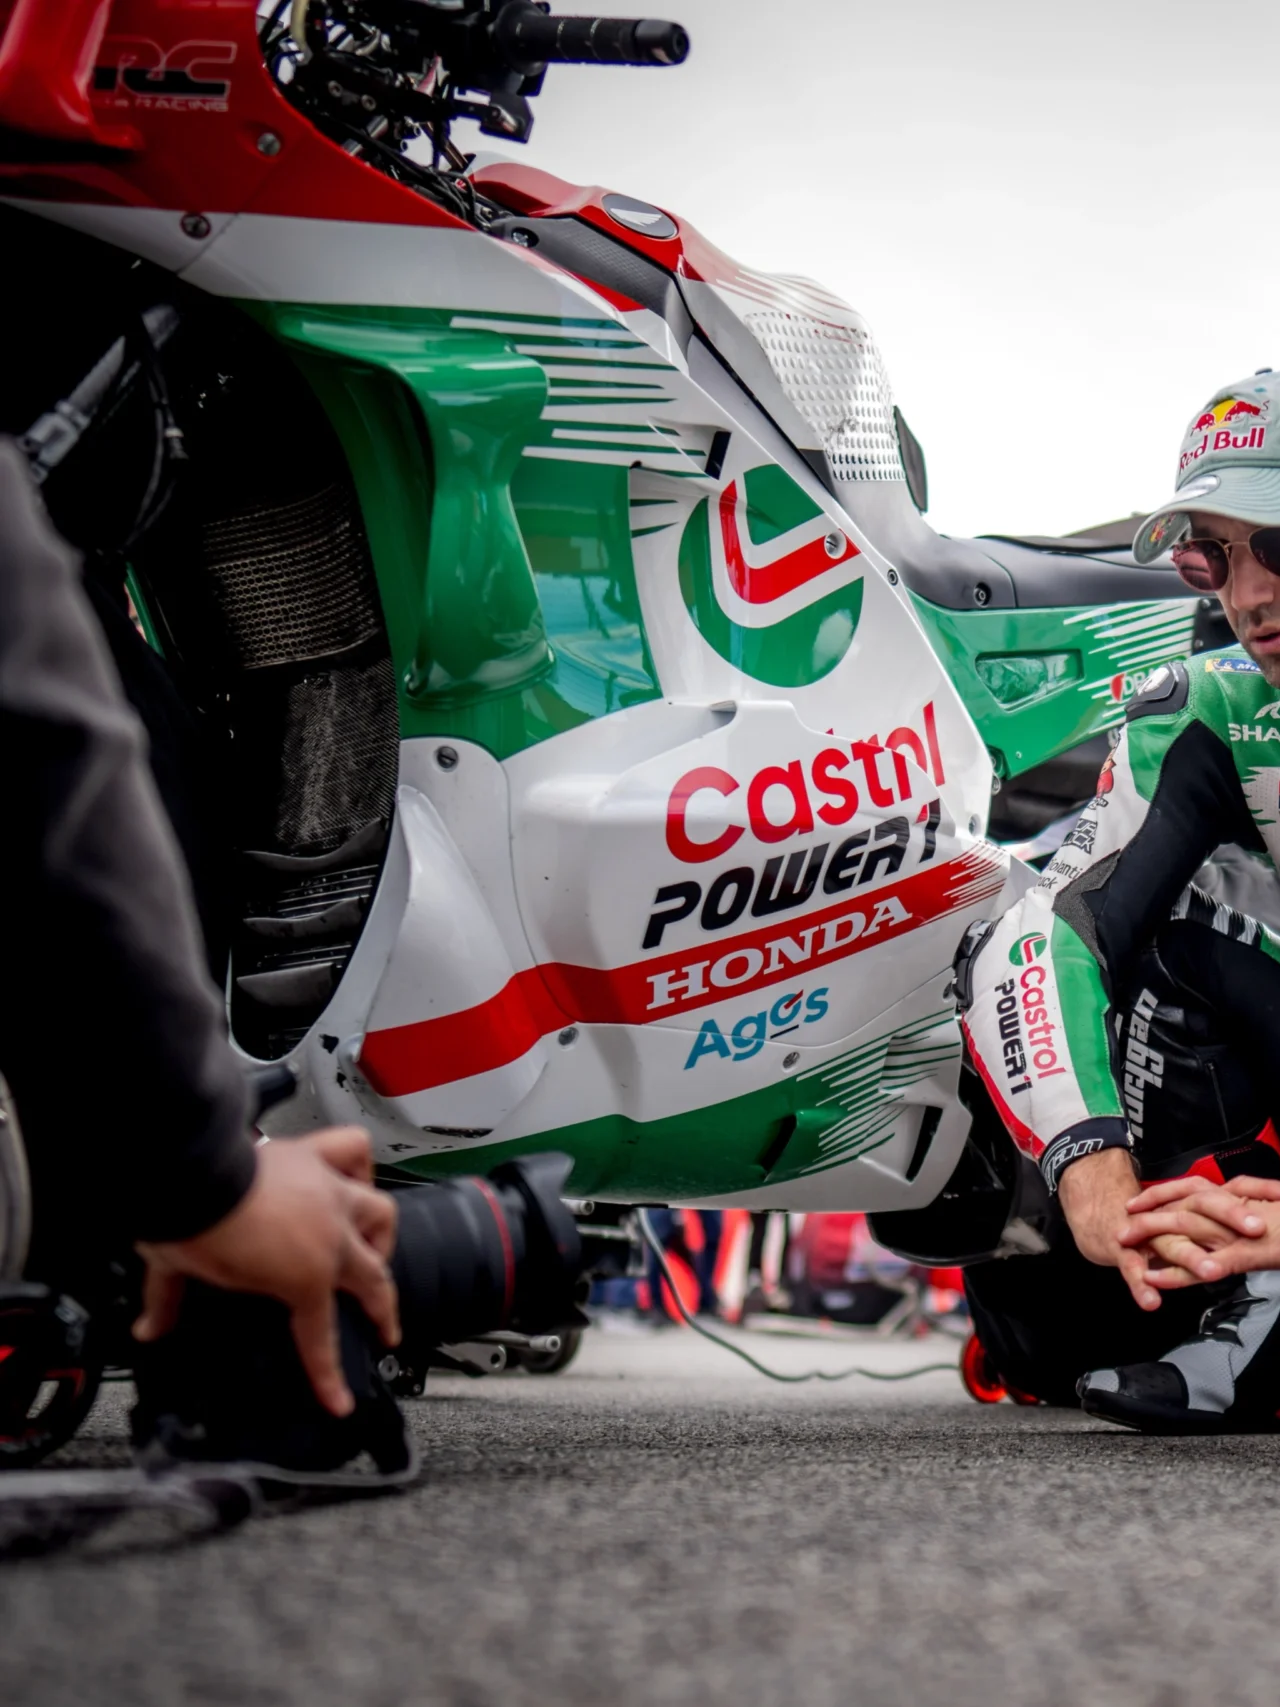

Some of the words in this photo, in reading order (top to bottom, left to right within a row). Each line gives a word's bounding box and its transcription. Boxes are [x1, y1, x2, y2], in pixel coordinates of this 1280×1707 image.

[1213, 427, 1265, 450] Bull
[665, 700, 945, 864] Castrol
[641, 798, 941, 949] POWER1
[646, 895, 912, 1009] HONDA
[994, 979, 1032, 1095] POWER1
[1020, 965, 1066, 1079] Castrol
